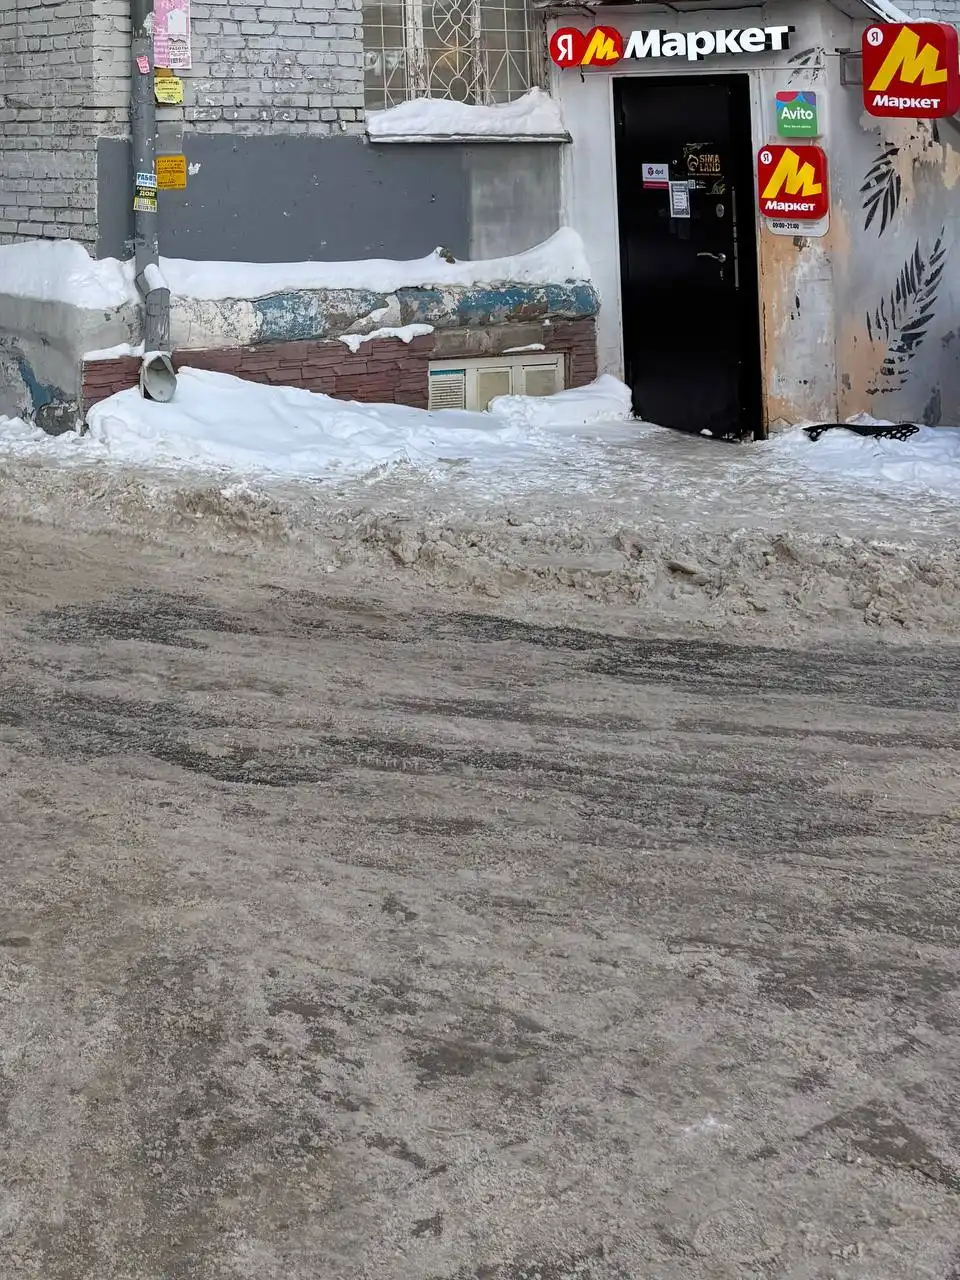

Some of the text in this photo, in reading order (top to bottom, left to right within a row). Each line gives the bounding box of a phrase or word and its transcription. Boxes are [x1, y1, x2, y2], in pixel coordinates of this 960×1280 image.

[557, 34, 573, 61] Я
[623, 25, 790, 61] Маркет
[872, 94, 941, 110] Маркет
[780, 107, 814, 120] Avito
[700, 163, 721, 171] LAND
[765, 201, 816, 212] Маркет
